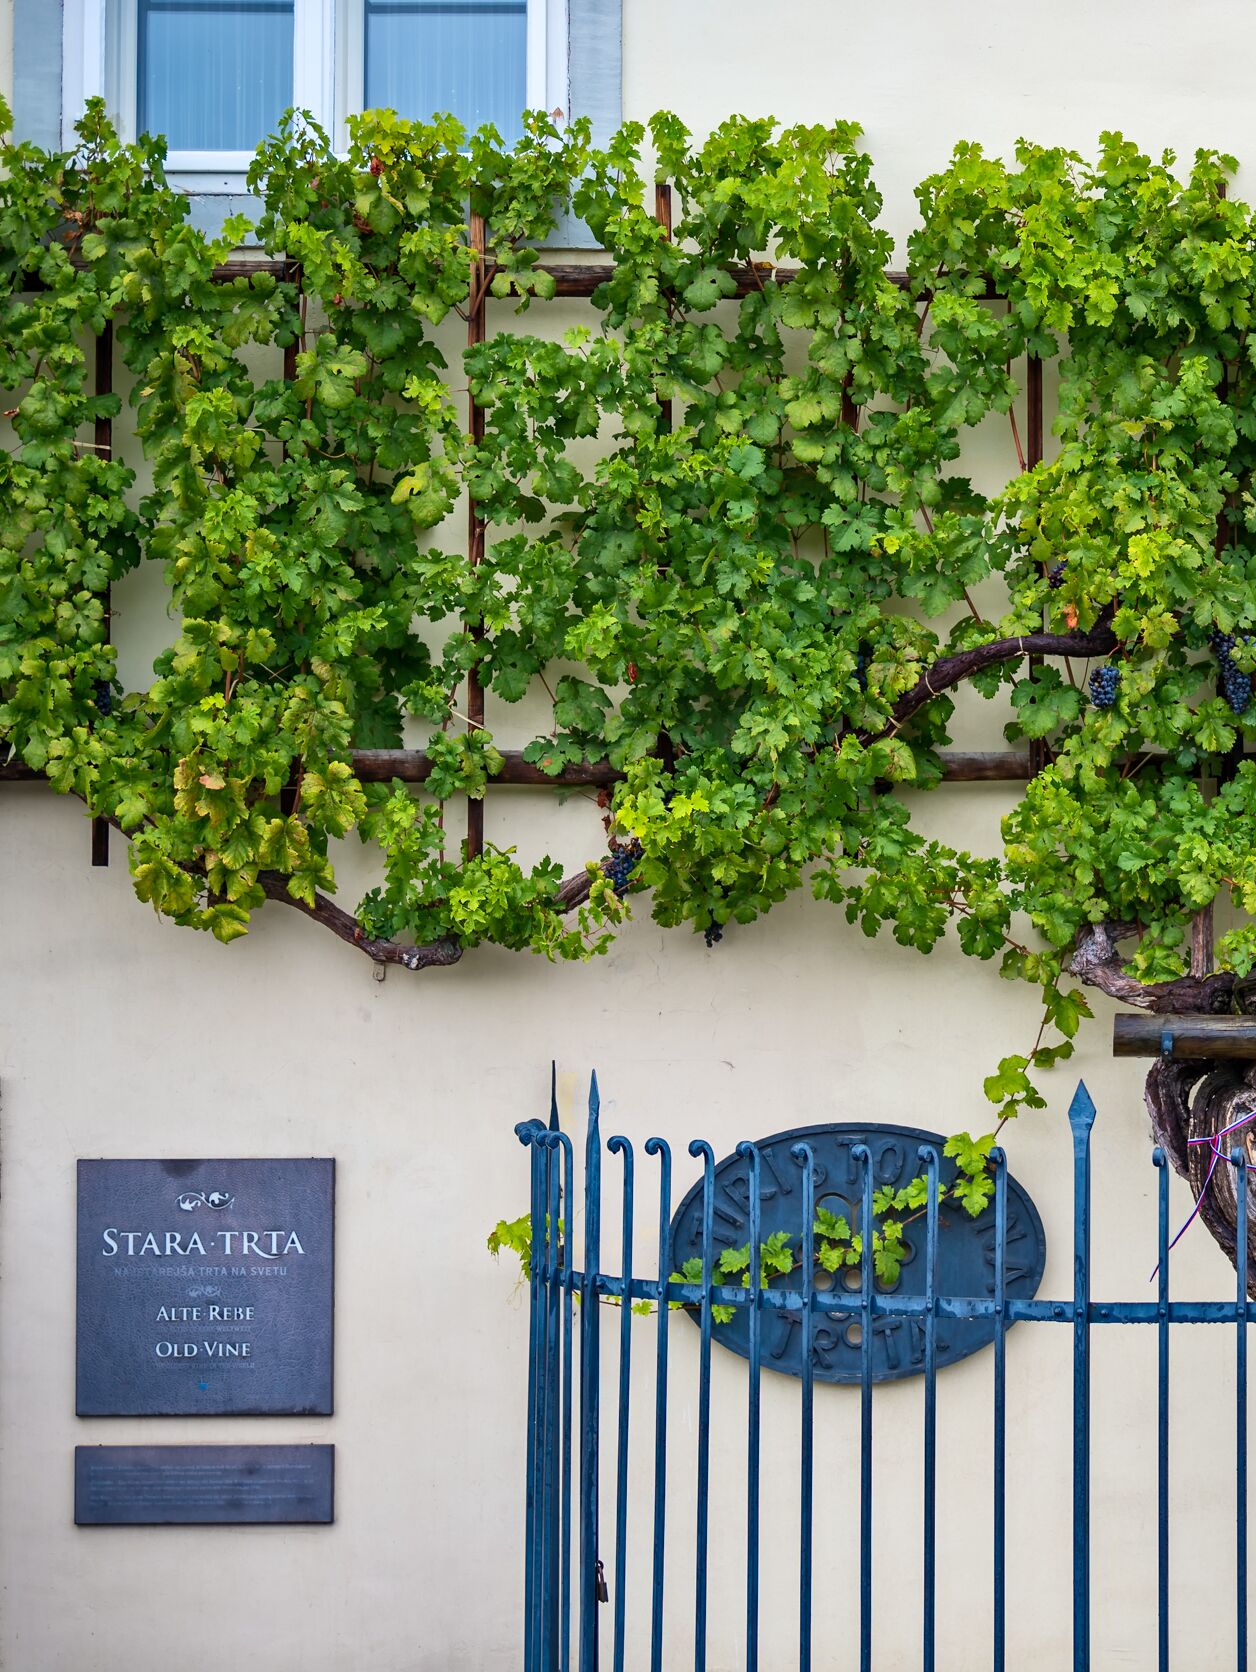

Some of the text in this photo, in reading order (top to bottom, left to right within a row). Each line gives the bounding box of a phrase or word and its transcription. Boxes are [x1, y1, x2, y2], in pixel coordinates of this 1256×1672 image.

[102, 1228, 306, 1259] STARA TRTA
[199, 1266, 228, 1277] TRTA
[231, 1266, 247, 1277] NA
[250, 1266, 287, 1277] SVETU
[156, 1305, 255, 1321] ALTE REBE
[155, 1341, 251, 1358] OLD VINE
